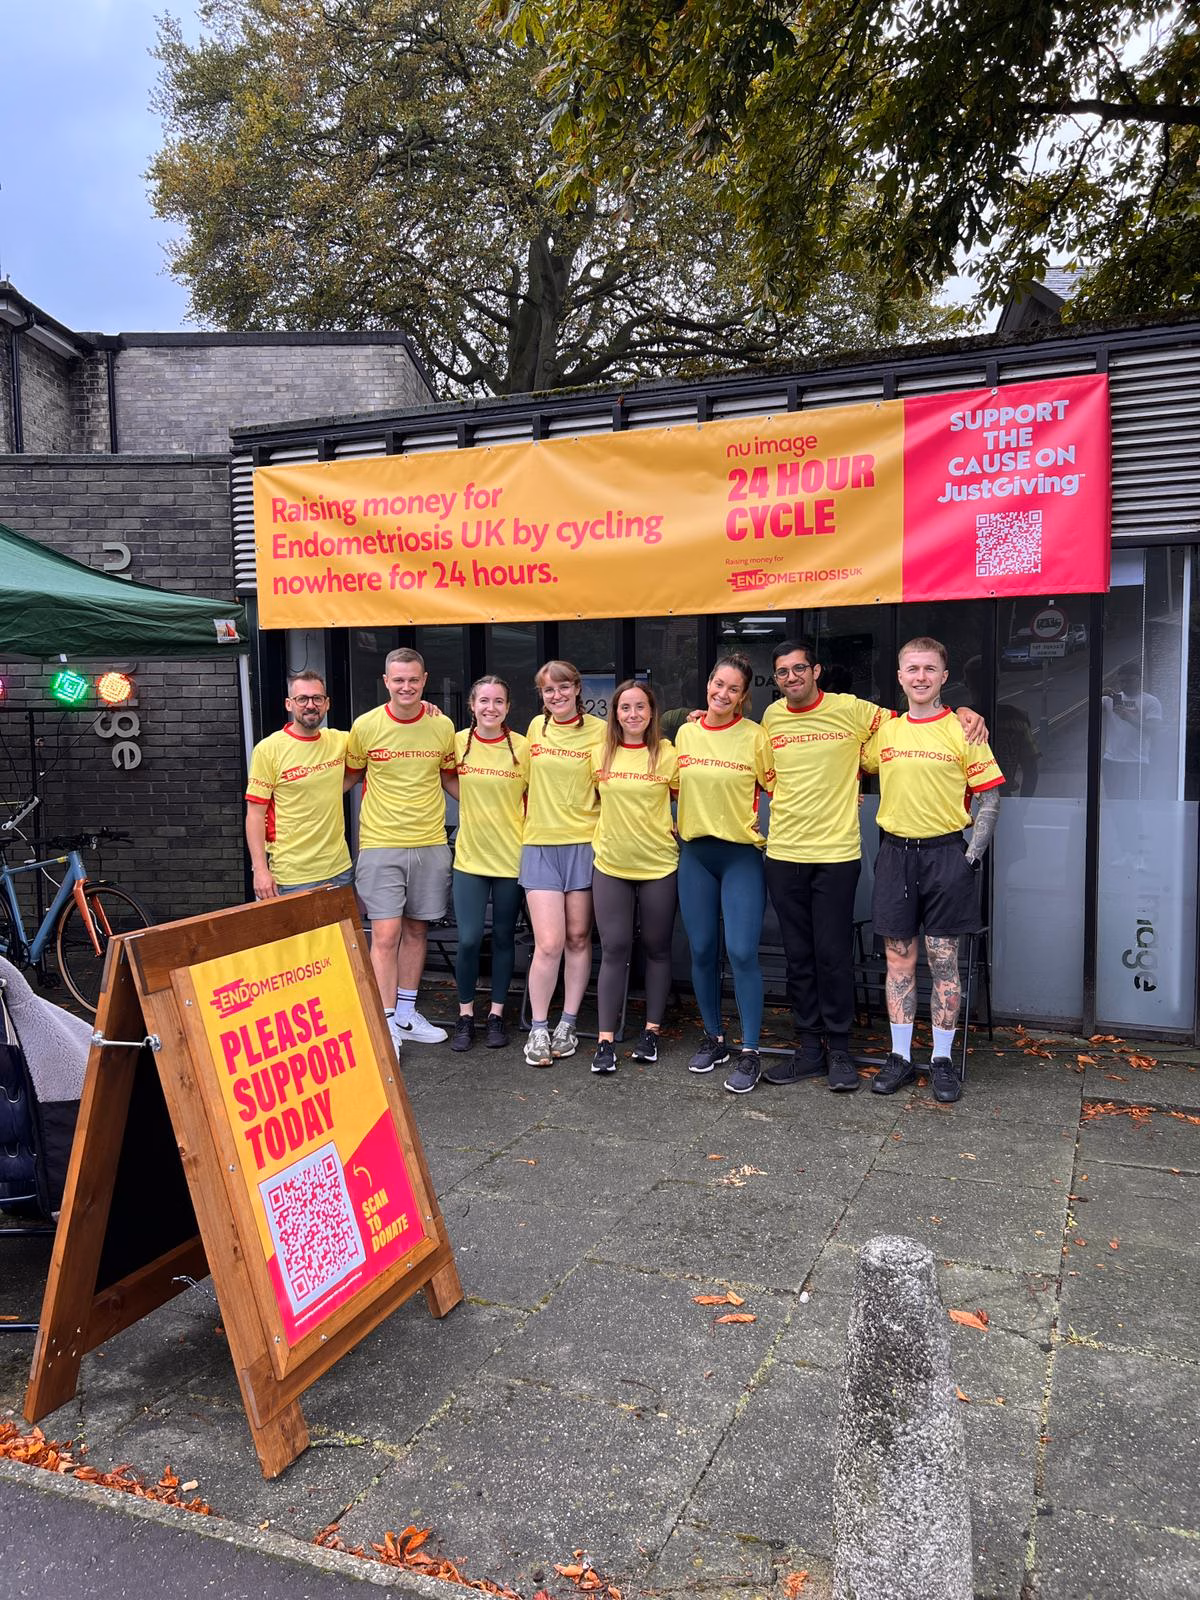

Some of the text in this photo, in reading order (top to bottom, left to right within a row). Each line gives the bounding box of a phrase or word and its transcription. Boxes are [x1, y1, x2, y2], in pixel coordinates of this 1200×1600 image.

[950, 400, 1070, 433] SUPPORT
[726, 434, 818, 460] nu image
[983, 426, 1034, 450] THE
[728, 453, 876, 503] 24 HOUR
[948, 445, 1076, 477] CAUSE ON
[271, 482, 503, 526] Raising money for
[725, 498, 836, 542] CYCLE
[271, 509, 664, 560] Endometriosis UK by cycling
[272, 558, 559, 596] nowhere for 24 hours.
[725, 554, 785, 567] Raising money for
[220, 996, 328, 1076] PLEASE
[232, 1029, 357, 1123] SUPPORT
[244, 1087, 336, 1171] TODAY
[362, 1187, 389, 1219] SCAN
[367, 1216, 382, 1233] TO
[370, 1211, 409, 1255] DONATE
